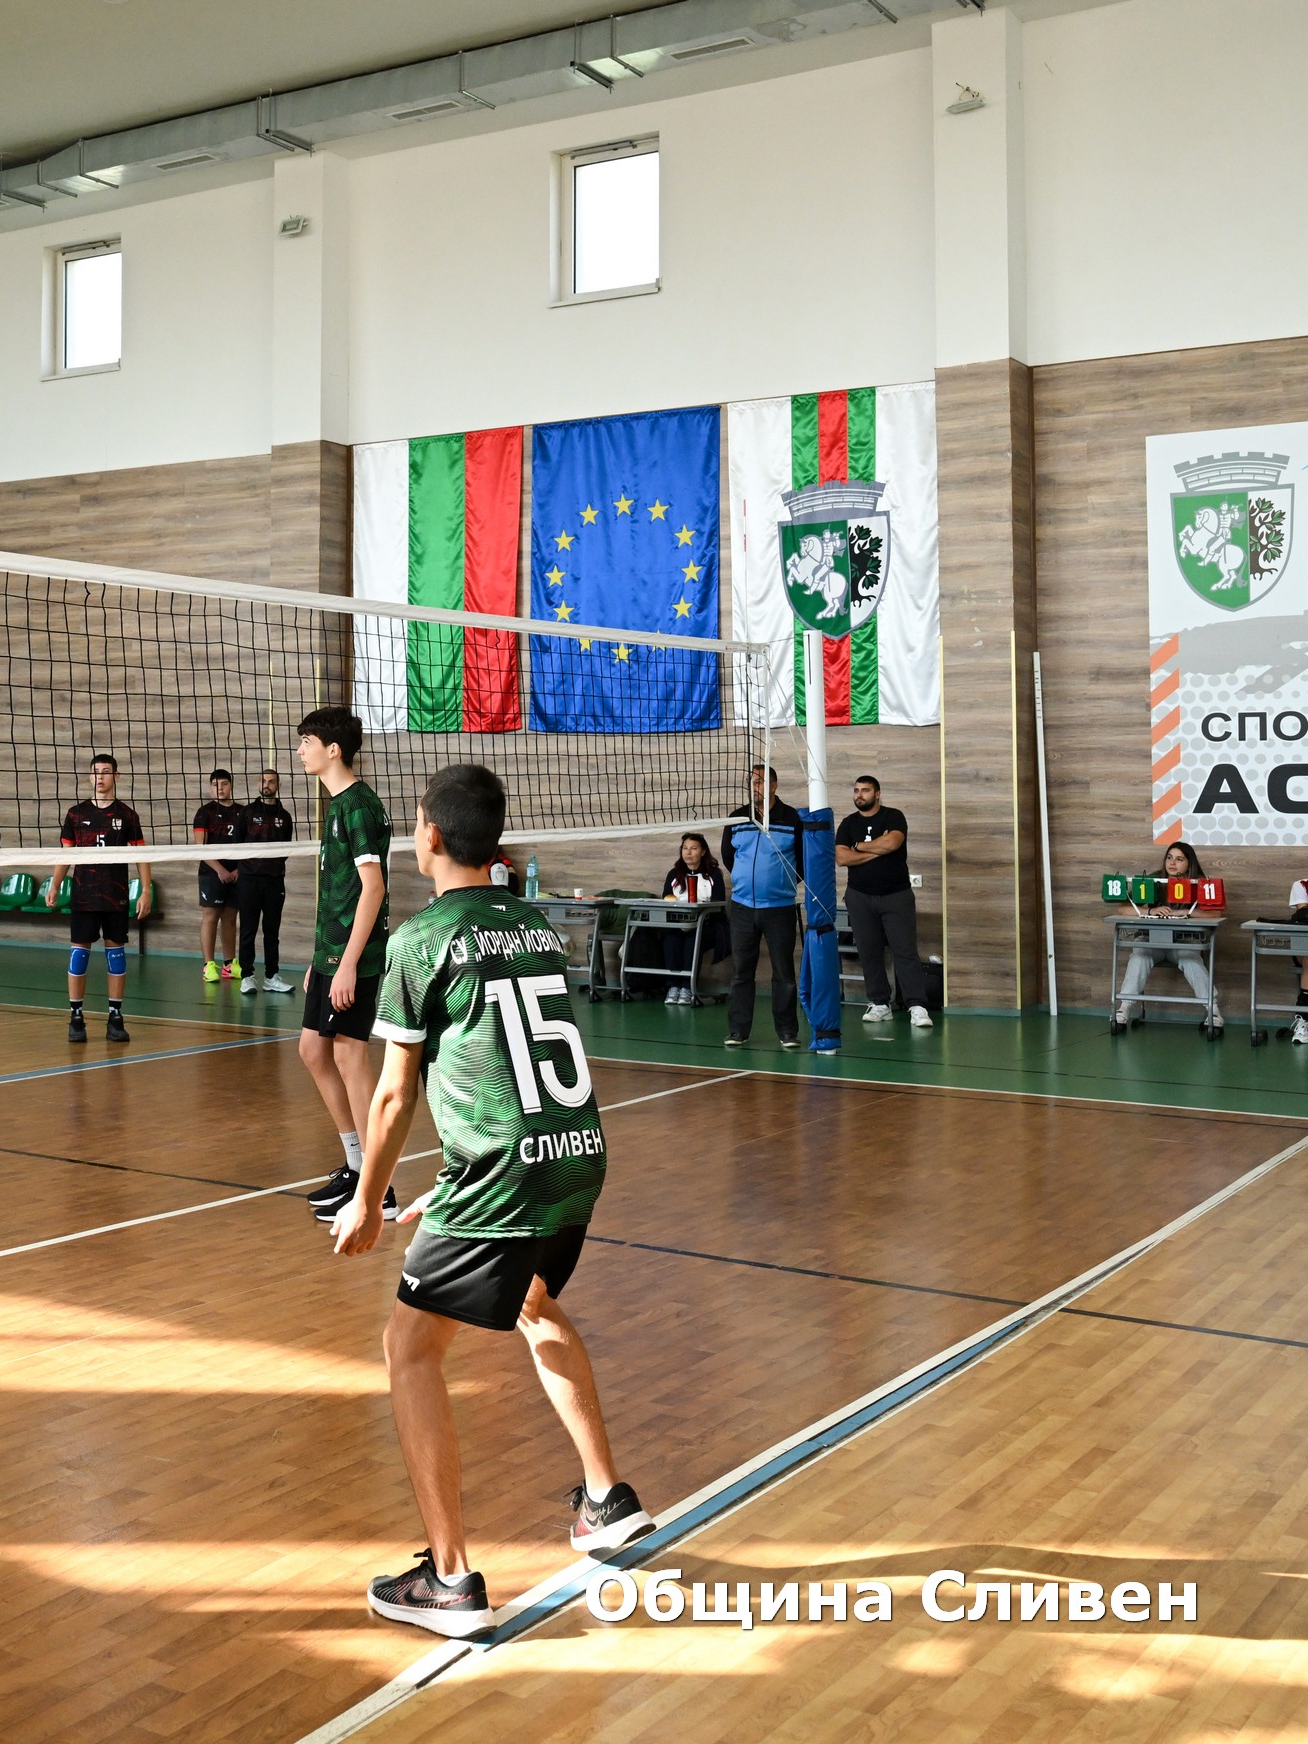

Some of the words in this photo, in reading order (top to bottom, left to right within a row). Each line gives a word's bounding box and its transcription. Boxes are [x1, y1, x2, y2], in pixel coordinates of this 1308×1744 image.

[1200, 710, 1308, 742] СПО
[227, 825, 234, 836] 2
[1107, 880, 1122, 896] 18
[1139, 883, 1146, 900] 1
[1174, 883, 1184, 899] 0
[1203, 883, 1216, 899] 11
[450, 936, 468, 964] СУ
[485, 974, 592, 1114] 15
[519, 1128, 604, 1164] СЛИВЕН
